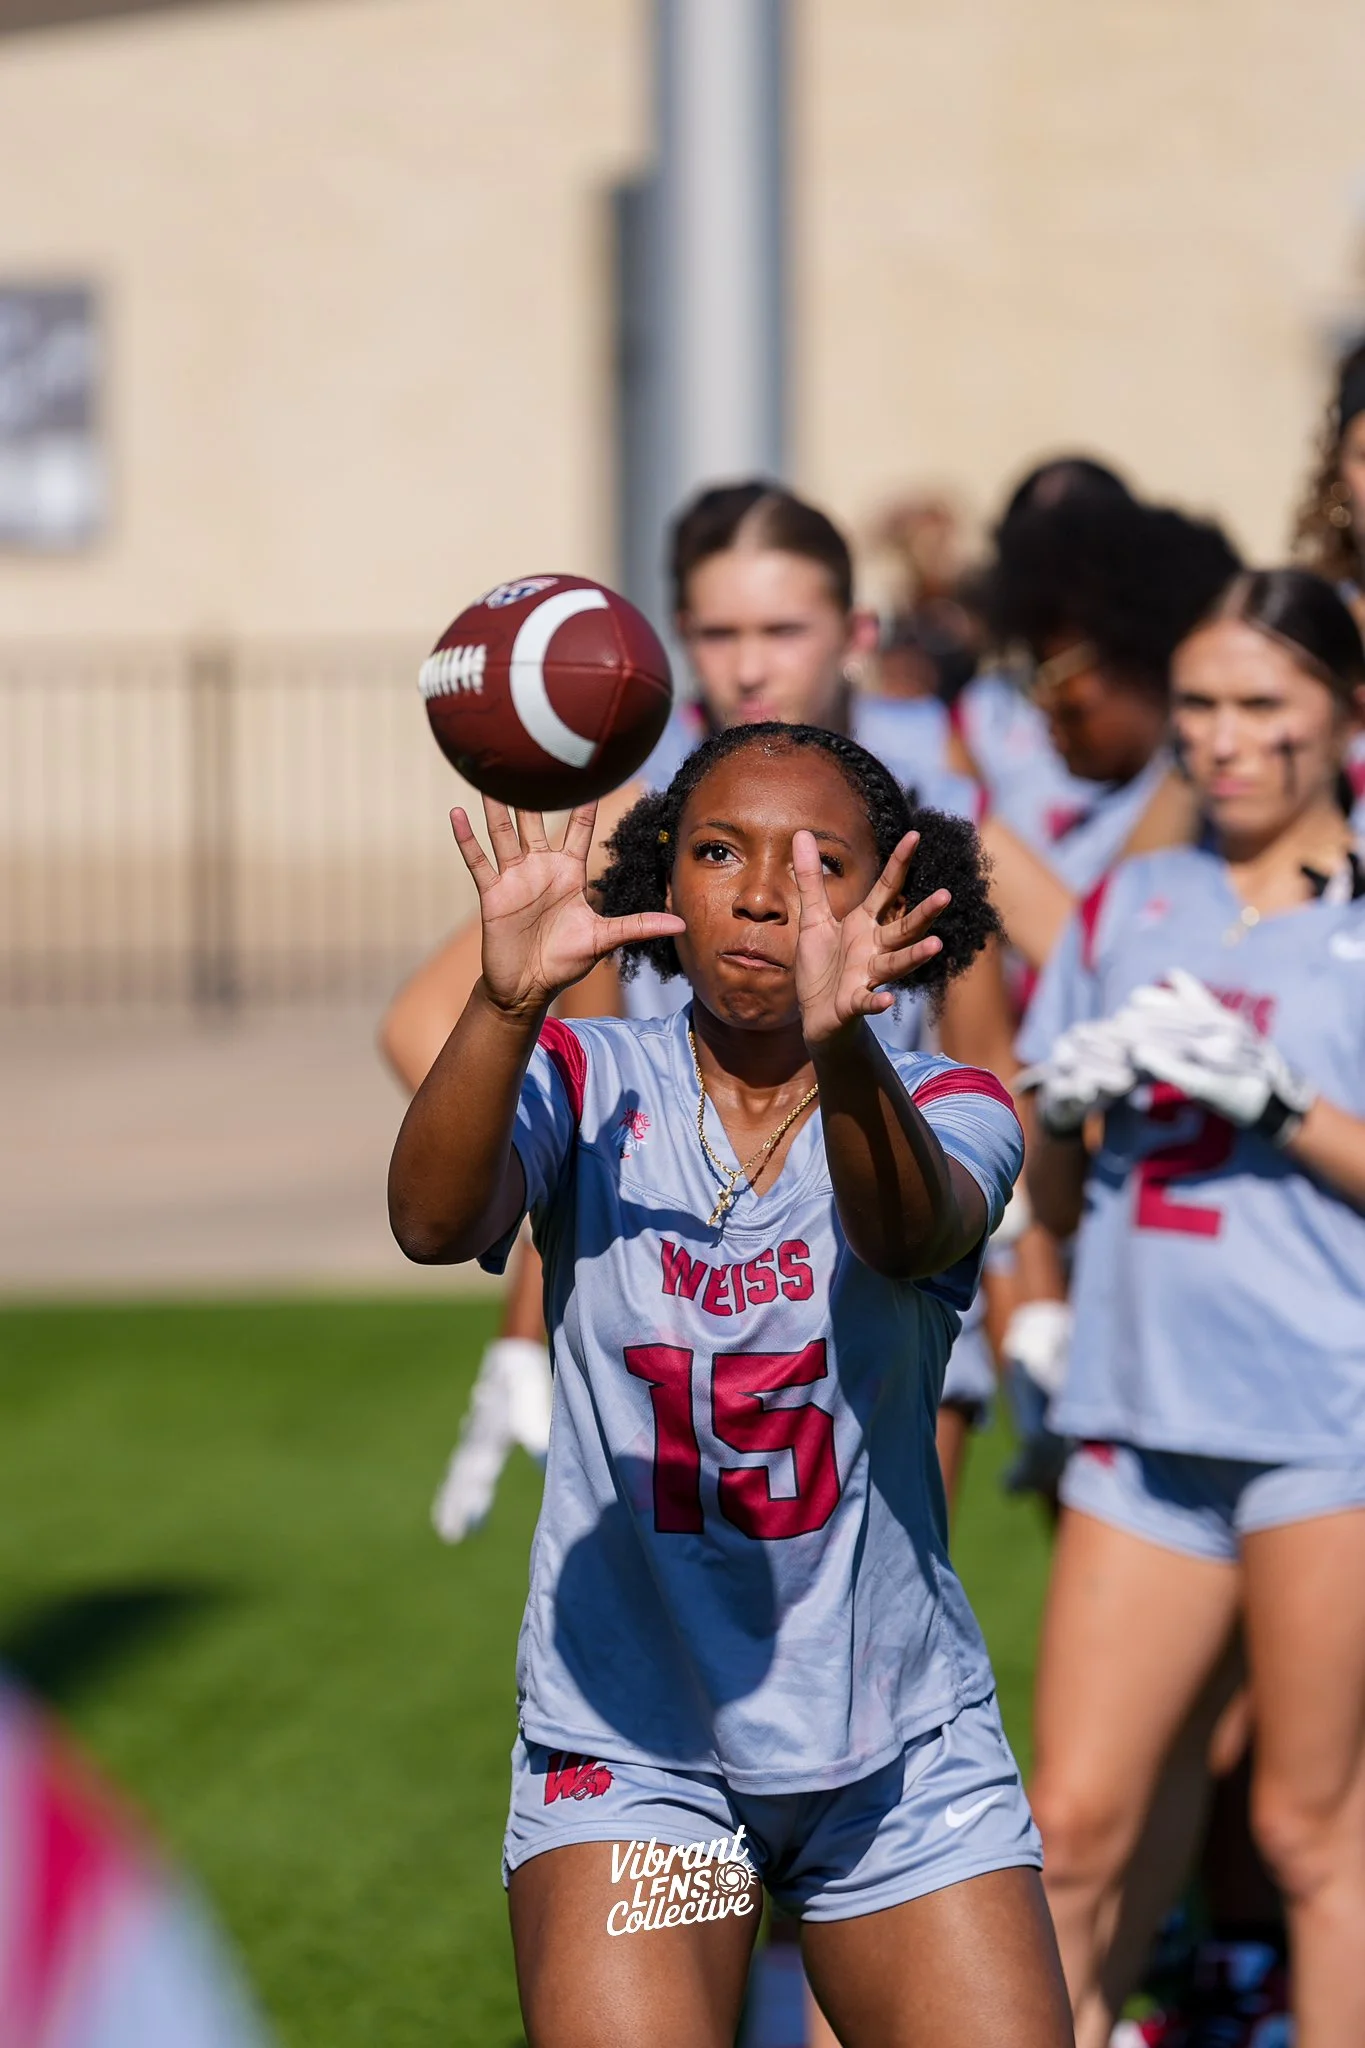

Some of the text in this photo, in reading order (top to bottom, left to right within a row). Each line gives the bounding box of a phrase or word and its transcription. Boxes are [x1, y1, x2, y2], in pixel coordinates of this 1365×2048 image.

[1136, 1080, 1233, 1237] 2
[660, 1237, 814, 1316] WEISS
[623, 1337, 841, 1540] 15
